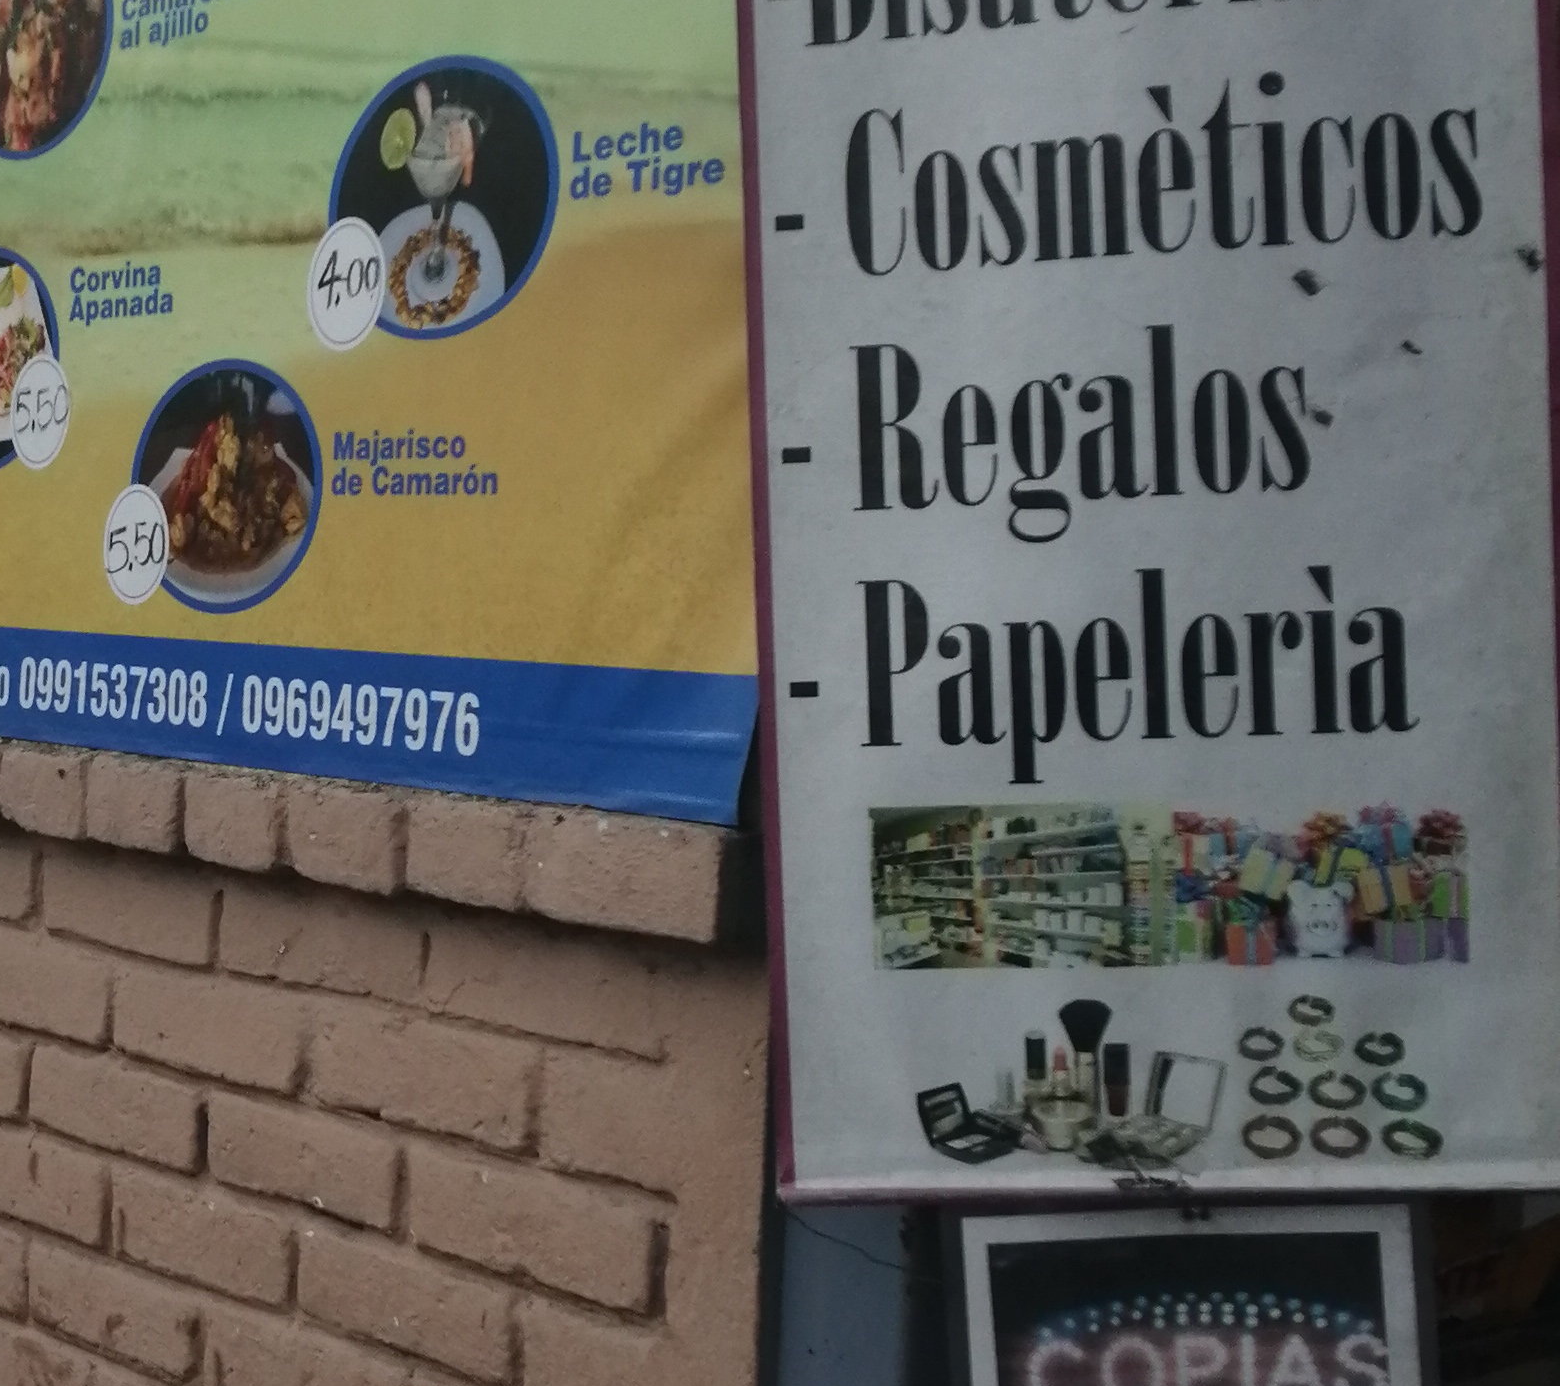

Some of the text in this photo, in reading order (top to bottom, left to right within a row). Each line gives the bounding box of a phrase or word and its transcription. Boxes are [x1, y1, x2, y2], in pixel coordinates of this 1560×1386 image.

[119, 8, 209, 50] al ajillo
[572, 121, 685, 164] Leche
[570, 154, 726, 201] de Tigre
[69, 261, 162, 295] Corvina
[68, 289, 174, 326] Apanada
[332, 427, 467, 467] Majarisco
[849, 323, 1314, 543] Regalos
[330, 463, 499, 497] de Camarón
[19, 655, 208, 728] 0991537308
[241, 673, 481, 758] 0969497976
